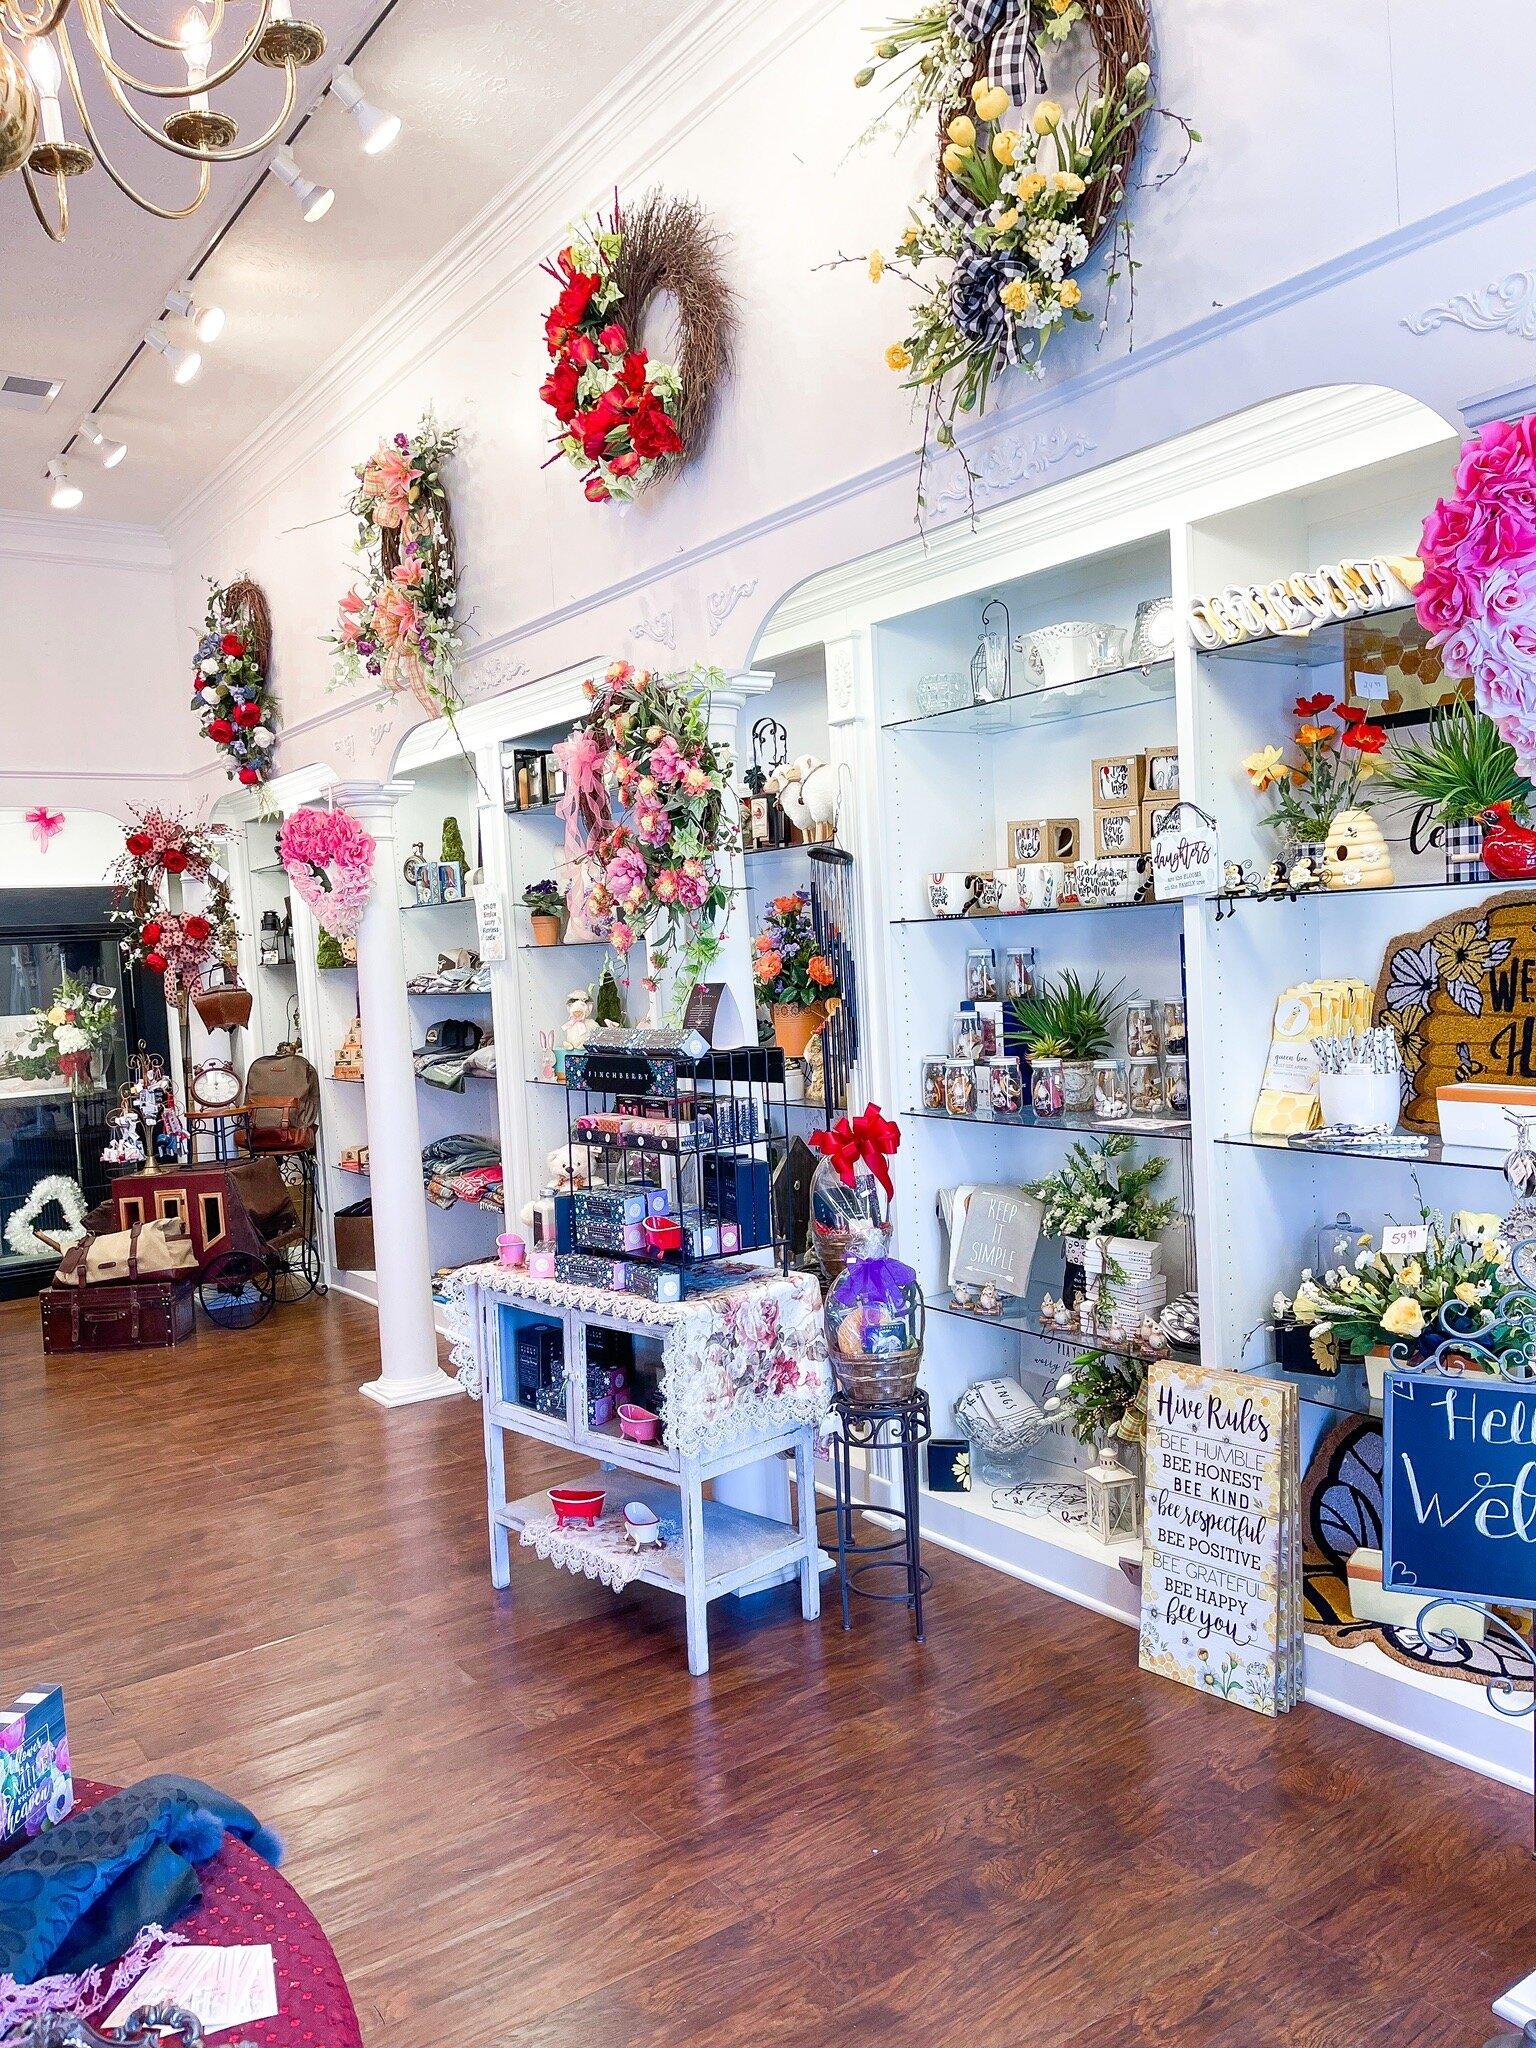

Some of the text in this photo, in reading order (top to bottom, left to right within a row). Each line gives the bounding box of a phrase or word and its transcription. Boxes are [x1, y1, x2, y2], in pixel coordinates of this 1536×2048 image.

[1153, 837, 1211, 873] daughters
[1178, 880, 1196, 889] FAMILY
[588, 1070, 650, 1081] FINCHBERRY
[988, 1198, 1018, 1223] KEEP
[992, 1222, 1005, 1243] IT
[970, 1241, 1016, 1272] SIMPLE
[1156, 1384, 1271, 1442] Hive Rules
[1159, 1432, 1267, 1473] BEE HUMBLE
[1162, 1453, 1263, 1492] BEE HONEST
[1173, 1476, 1250, 1510] BEE KIND
[1157, 1488, 1266, 1546] bee respectful
[1157, 1527, 1262, 1572] BEE POSITIVE
[1152, 1550, 1268, 1602] BEE GRATEFUL
[1164, 1576, 1249, 1617] BEE HAPPY
[1165, 1595, 1251, 1646] bee you
[7, 1786, 49, 1835] heaven
